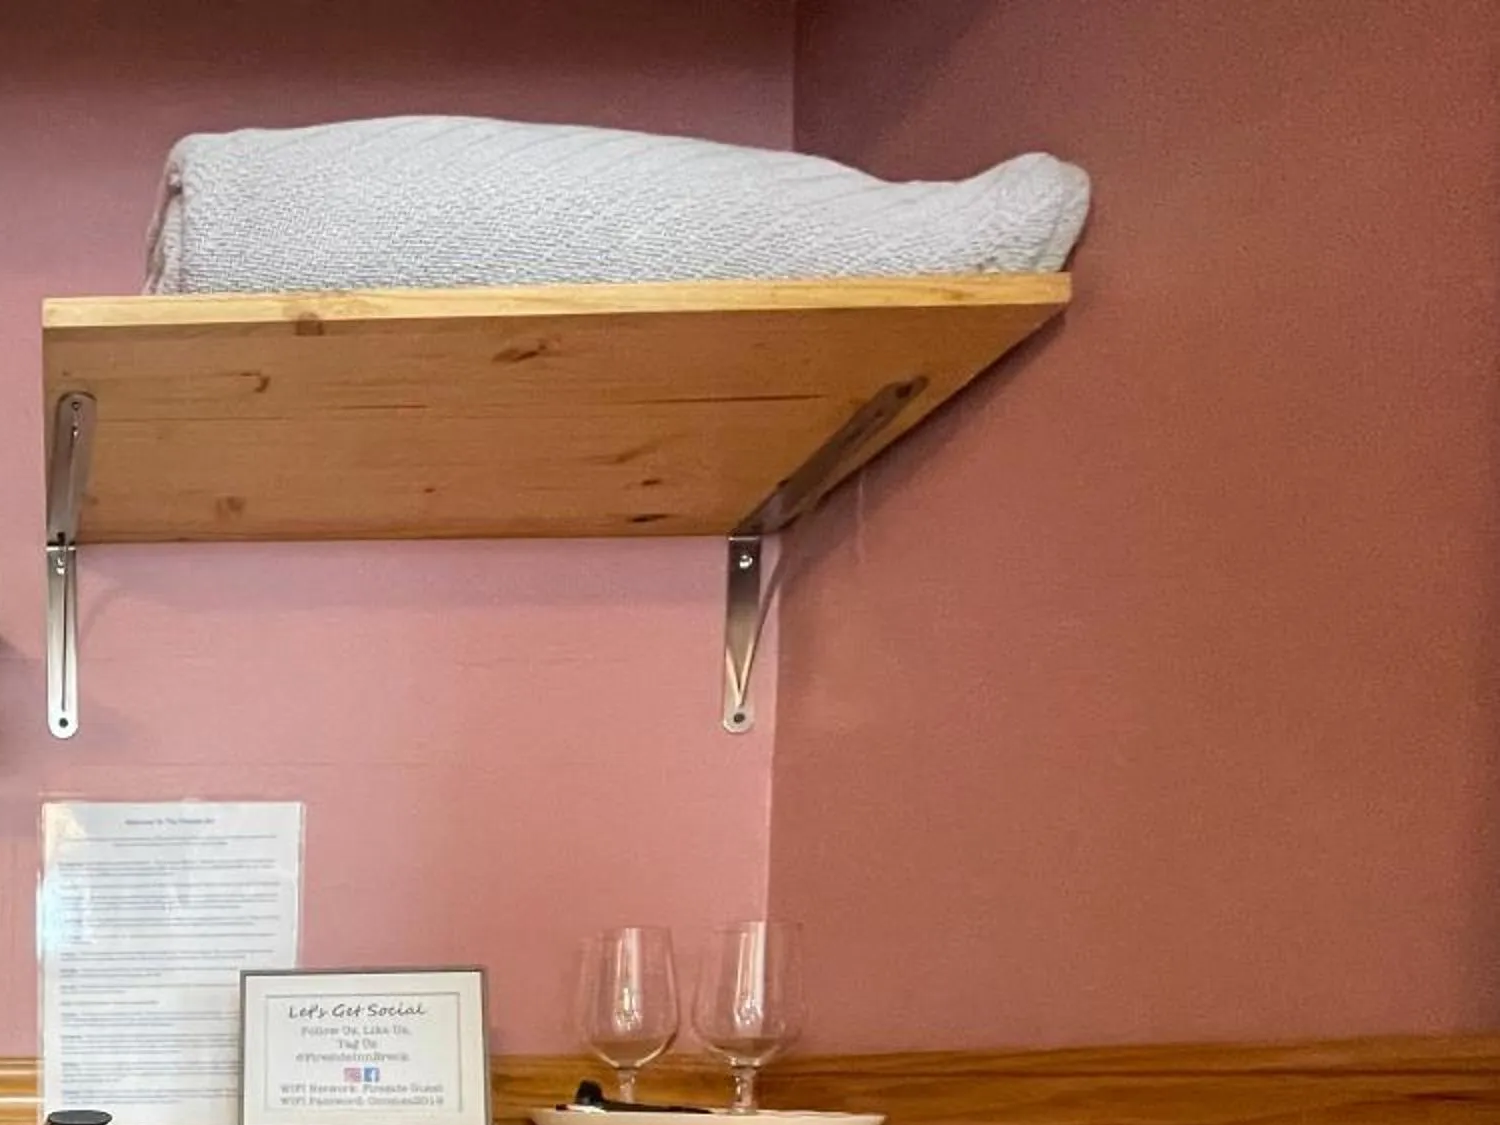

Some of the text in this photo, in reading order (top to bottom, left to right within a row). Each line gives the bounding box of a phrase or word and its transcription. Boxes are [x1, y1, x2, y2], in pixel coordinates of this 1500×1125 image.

[288, 1002, 428, 1020] Let's Get Social
